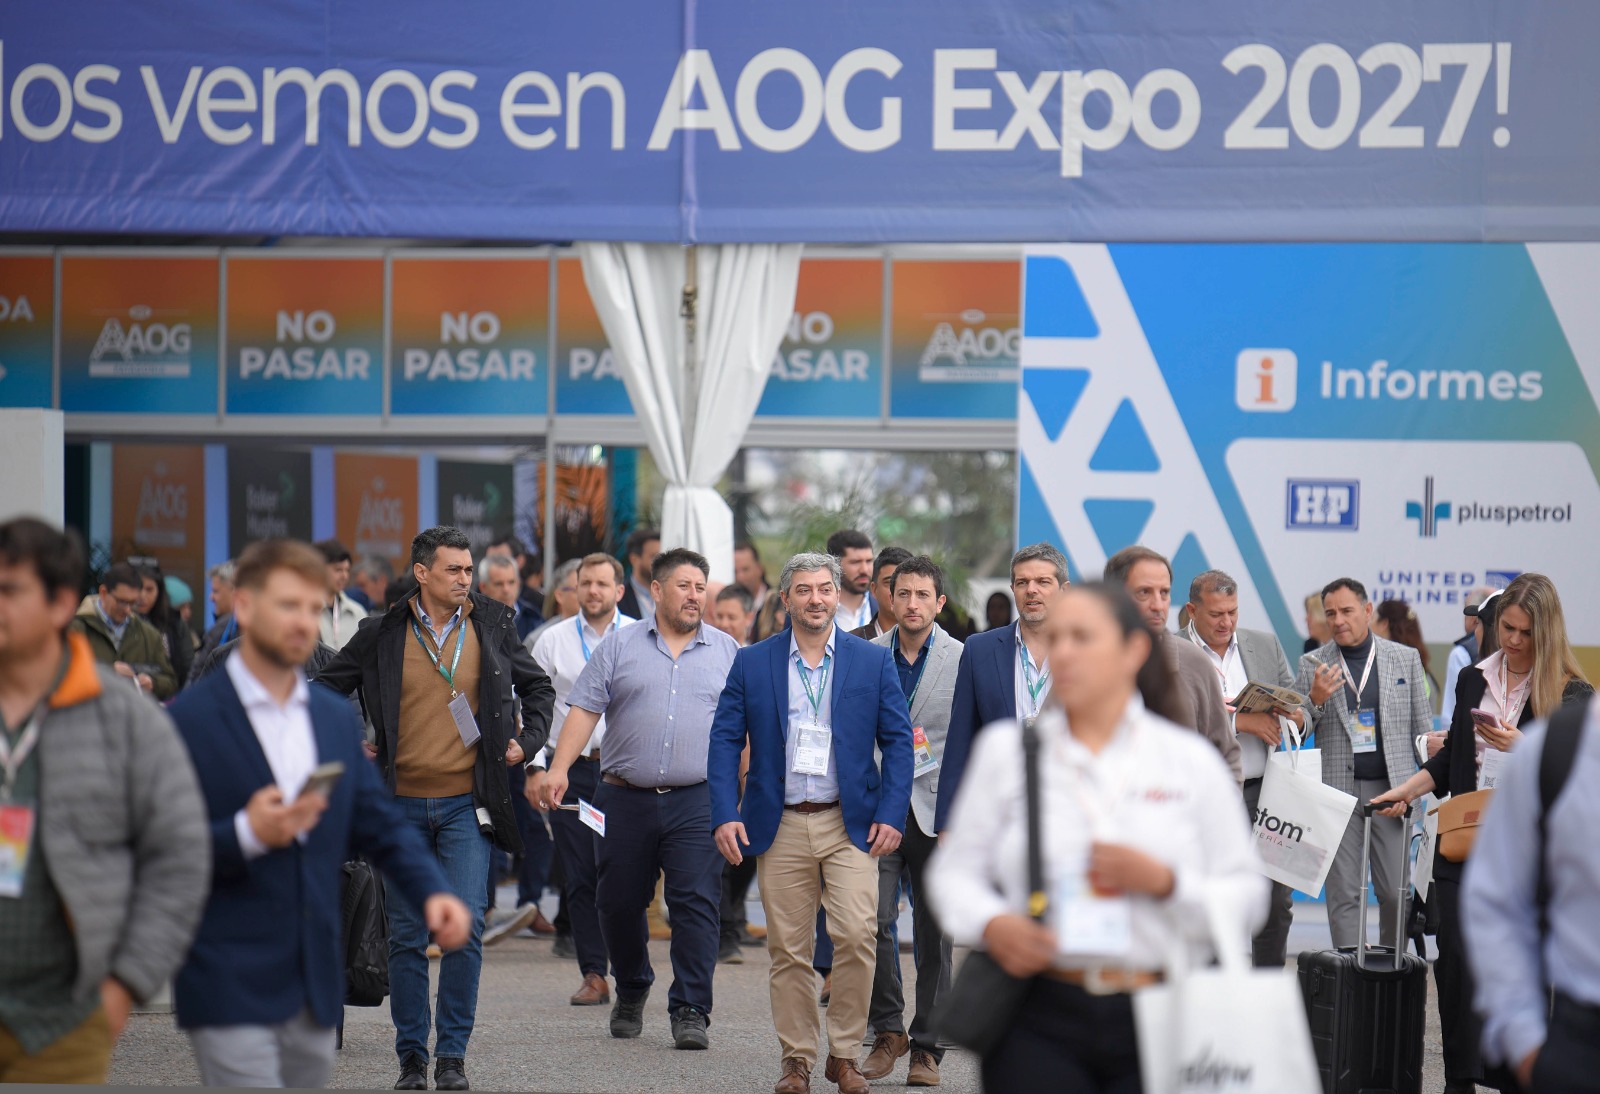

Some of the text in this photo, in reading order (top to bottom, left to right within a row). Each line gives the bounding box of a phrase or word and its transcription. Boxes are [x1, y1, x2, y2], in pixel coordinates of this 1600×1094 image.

[0, 40, 1513, 178] os vemos en AOG Expo 2027!
[276, 310, 336, 343] NO
[440, 312, 501, 344] NO
[239, 347, 371, 380] PASAR
[403, 349, 536, 381] PASAR
[768, 349, 870, 382] ASAR
[1320, 360, 1543, 400] Informes
[1457, 501, 1572, 526] pluspetrol
[1378, 570, 1476, 587] UNITED
[1373, 589, 1469, 604] IRLINE
